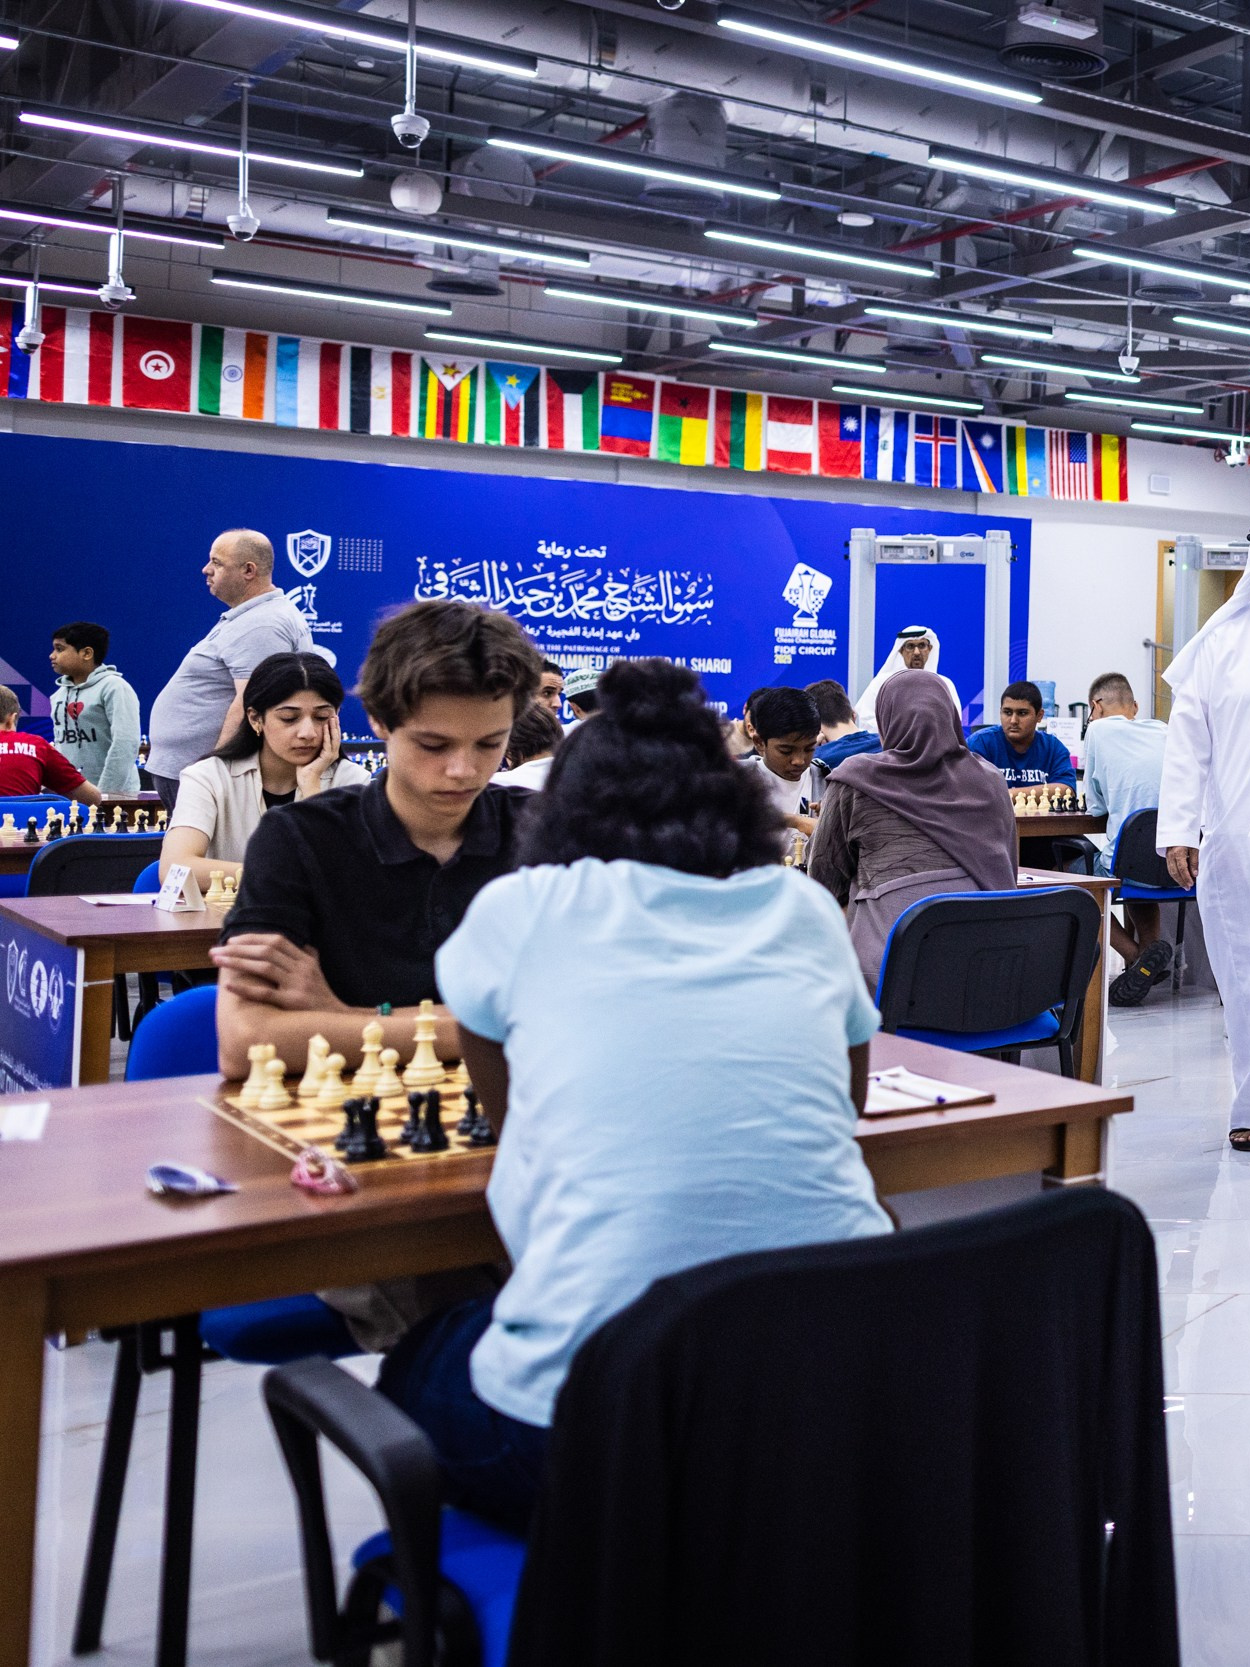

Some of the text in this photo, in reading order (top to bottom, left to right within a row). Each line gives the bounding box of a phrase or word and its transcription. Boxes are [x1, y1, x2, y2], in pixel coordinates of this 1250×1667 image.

[537, 540, 607, 559] تحت رعاية
[546, 625, 581, 638] الفجيرة
[582, 626, 604, 640] إمارة
[605, 630, 623, 640] عهد
[624, 628, 640, 643] ولي
[774, 645, 836, 656] FIDE CIRCUIT
[690, 657, 732, 675] SHARQI
